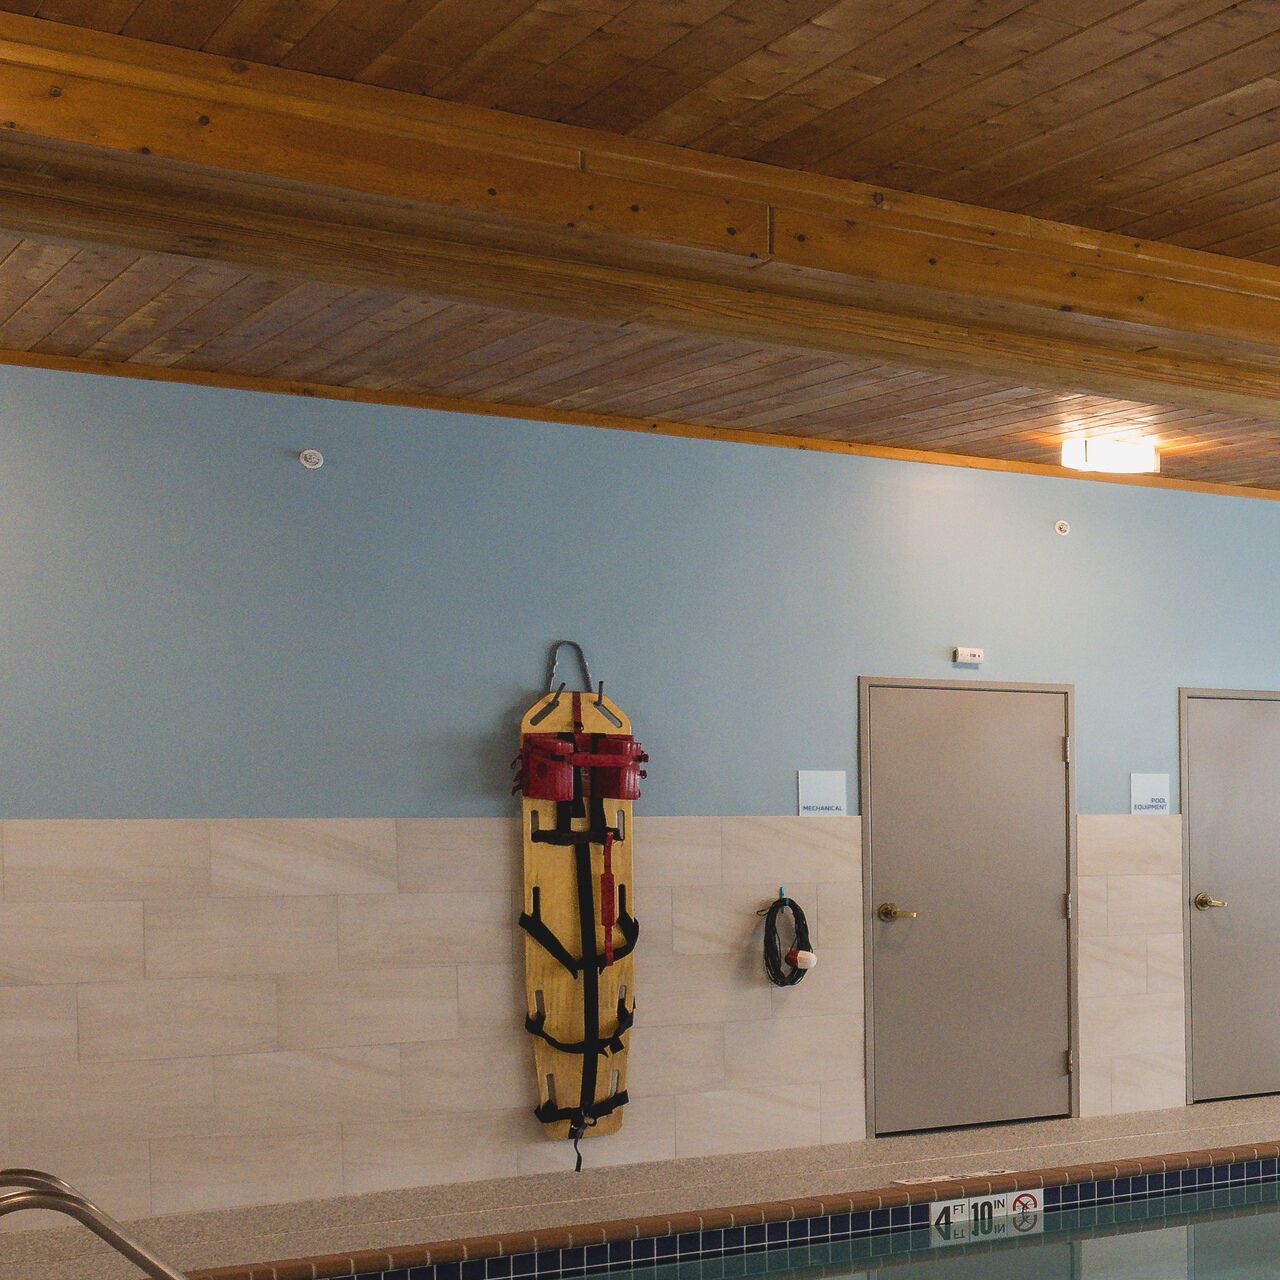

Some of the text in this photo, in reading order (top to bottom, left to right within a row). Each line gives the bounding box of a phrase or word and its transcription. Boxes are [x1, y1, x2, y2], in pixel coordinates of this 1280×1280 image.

[934, 1198, 1005, 1225] 4 FT 10 IN
